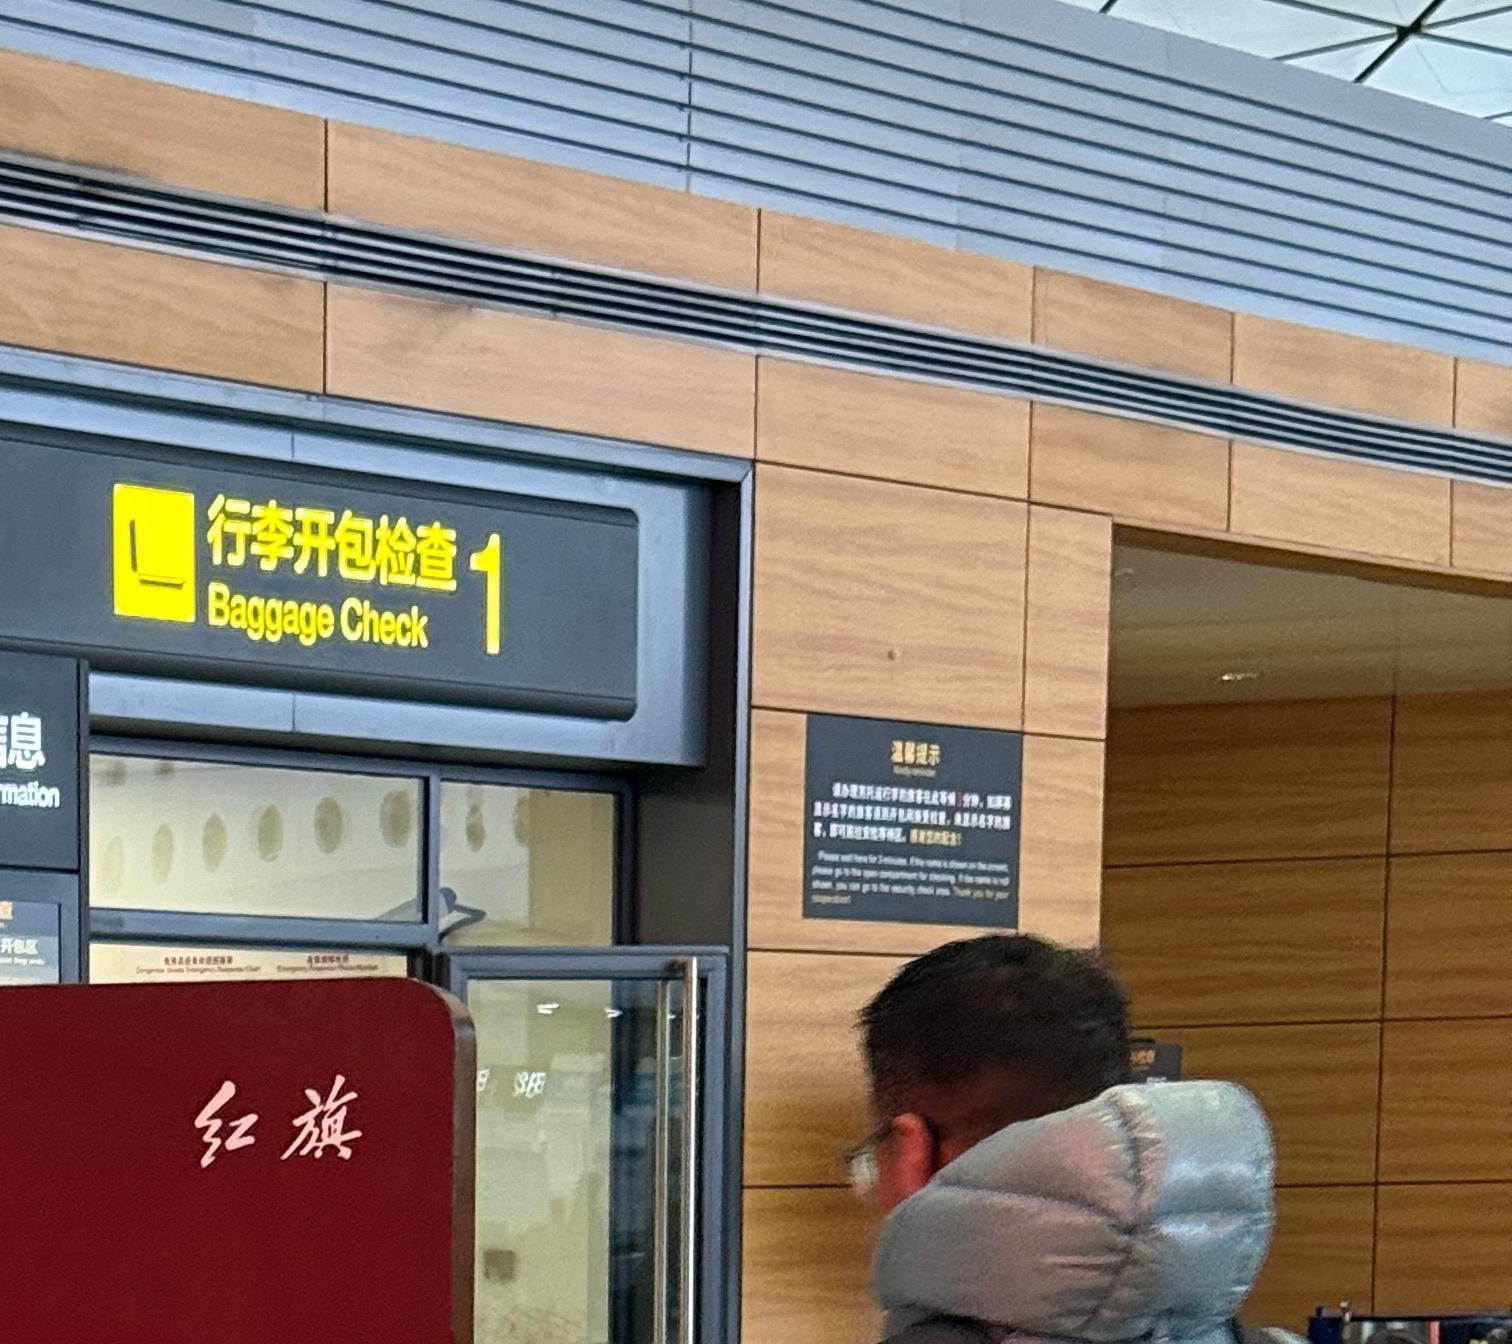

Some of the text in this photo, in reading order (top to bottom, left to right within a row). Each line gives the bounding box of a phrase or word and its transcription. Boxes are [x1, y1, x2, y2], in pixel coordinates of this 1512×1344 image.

[207, 494, 458, 592] 行李开包检查
[207, 582, 429, 649] Baggage Check
[469, 533, 501, 655] 1
[194, 1073, 364, 1169] 红旗
